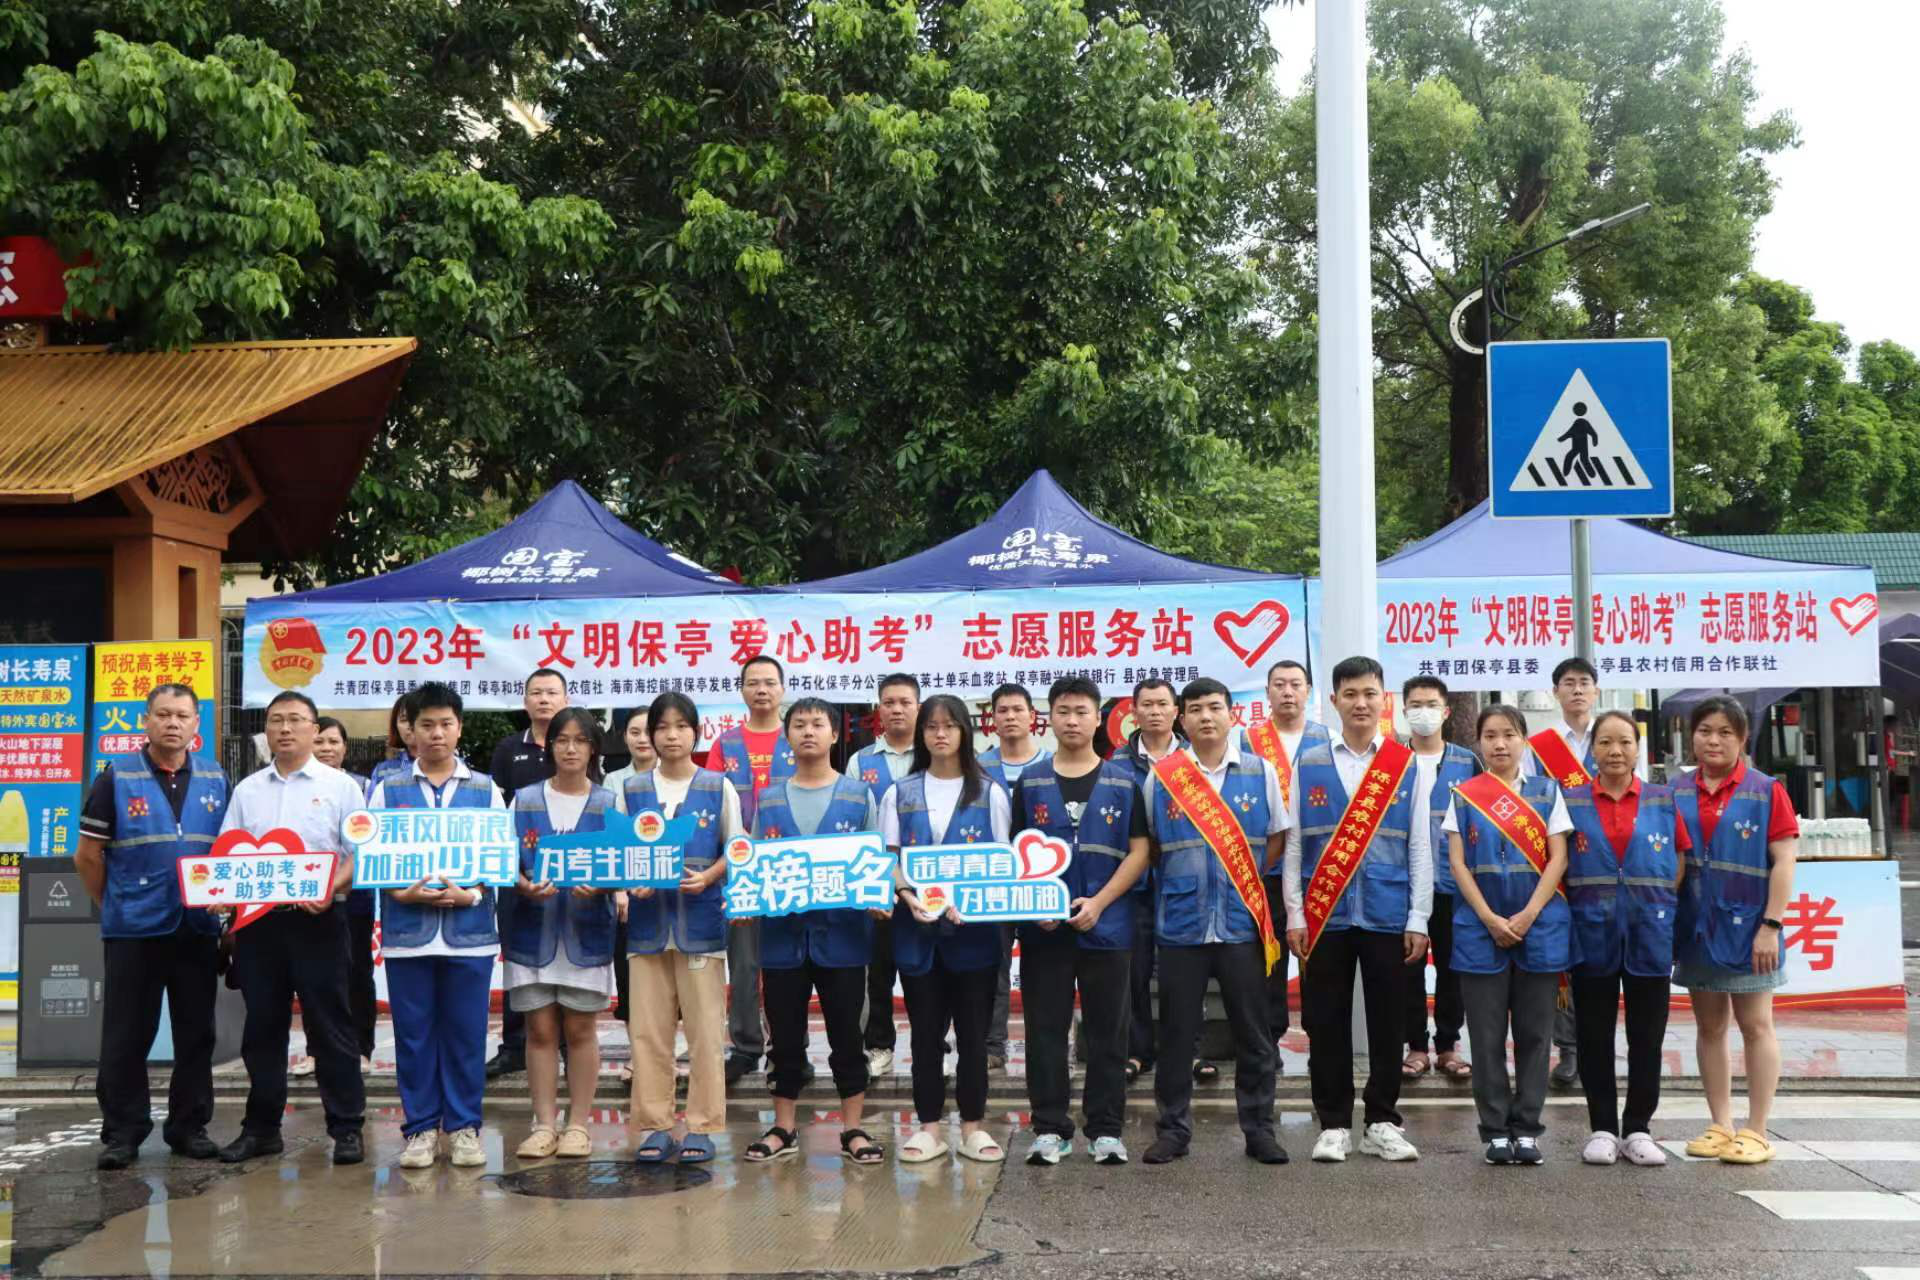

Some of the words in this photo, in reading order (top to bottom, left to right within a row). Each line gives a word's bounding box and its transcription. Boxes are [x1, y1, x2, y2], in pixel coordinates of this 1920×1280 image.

[968, 545, 1110, 566] 椰树长寿泉
[461, 565, 602, 578] 椰树长寿泉
[1386, 597, 1460, 648] 2023年
[1700, 590, 1817, 644] 志愿服务站
[345, 623, 485, 670] 2023年
[962, 607, 1194, 660] 志愿服务站
[101, 651, 206, 674] 预祝高考学子
[1419, 658, 1539, 675] 共青团保亭县委
[1122, 664, 1200, 684] 县应急管理局
[380, 815, 508, 843] 乘风破浪
[214, 860, 297, 881] 爱心助考
[539, 845, 681, 881] 为考生喝彩
[234, 880, 318, 899] 助梦飞翔
[727, 851, 893, 912] 金榜题名
